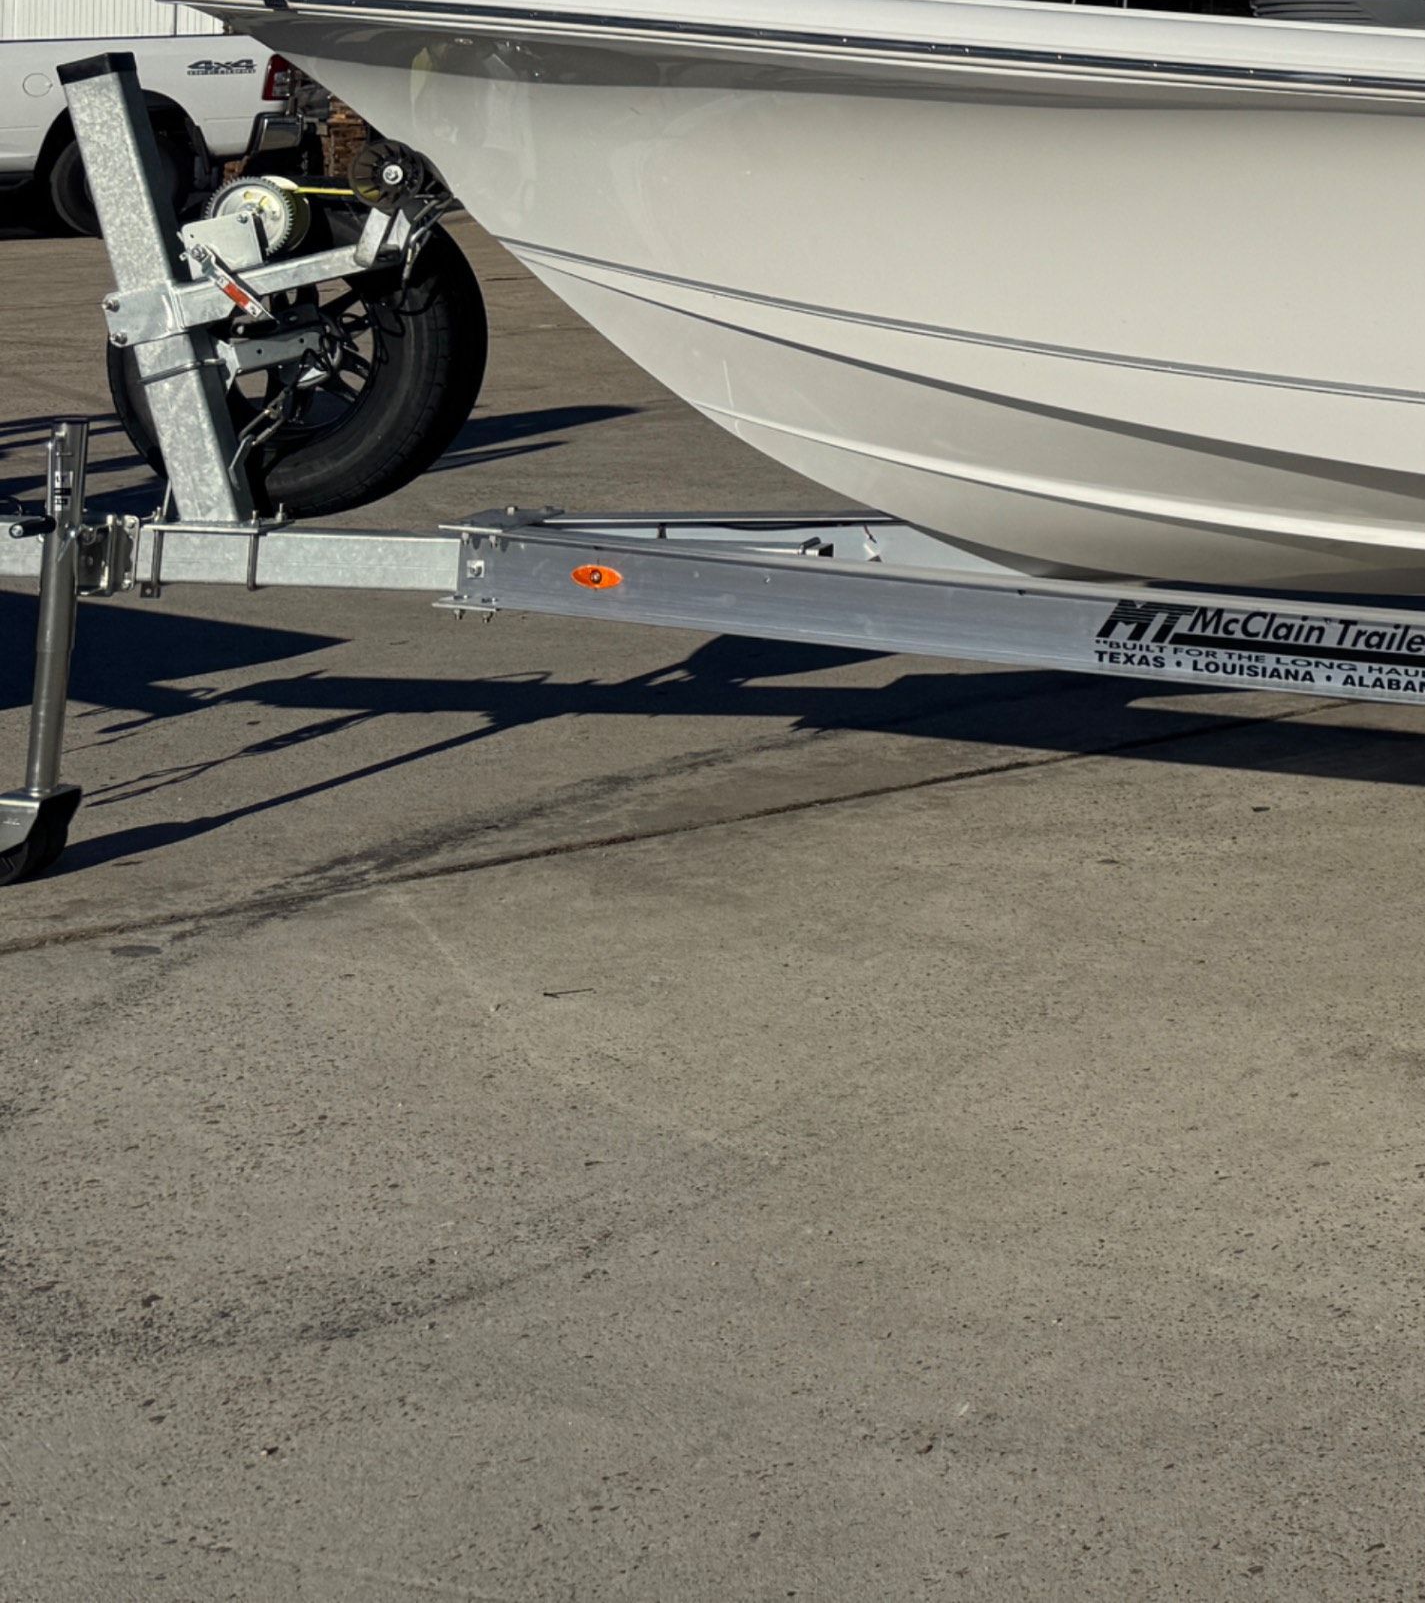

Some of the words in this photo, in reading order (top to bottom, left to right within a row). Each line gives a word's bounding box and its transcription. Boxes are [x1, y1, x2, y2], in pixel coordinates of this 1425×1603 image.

[1096, 599, 1198, 644] MT
[1187, 606, 1327, 644] McClain
[1094, 650, 1166, 668] TEXAS
[1192, 660, 1315, 682] LOUISIANA
[1173, 647, 1218, 659] FOR
[1224, 651, 1266, 664] THE
[1275, 657, 1358, 671] LONG
